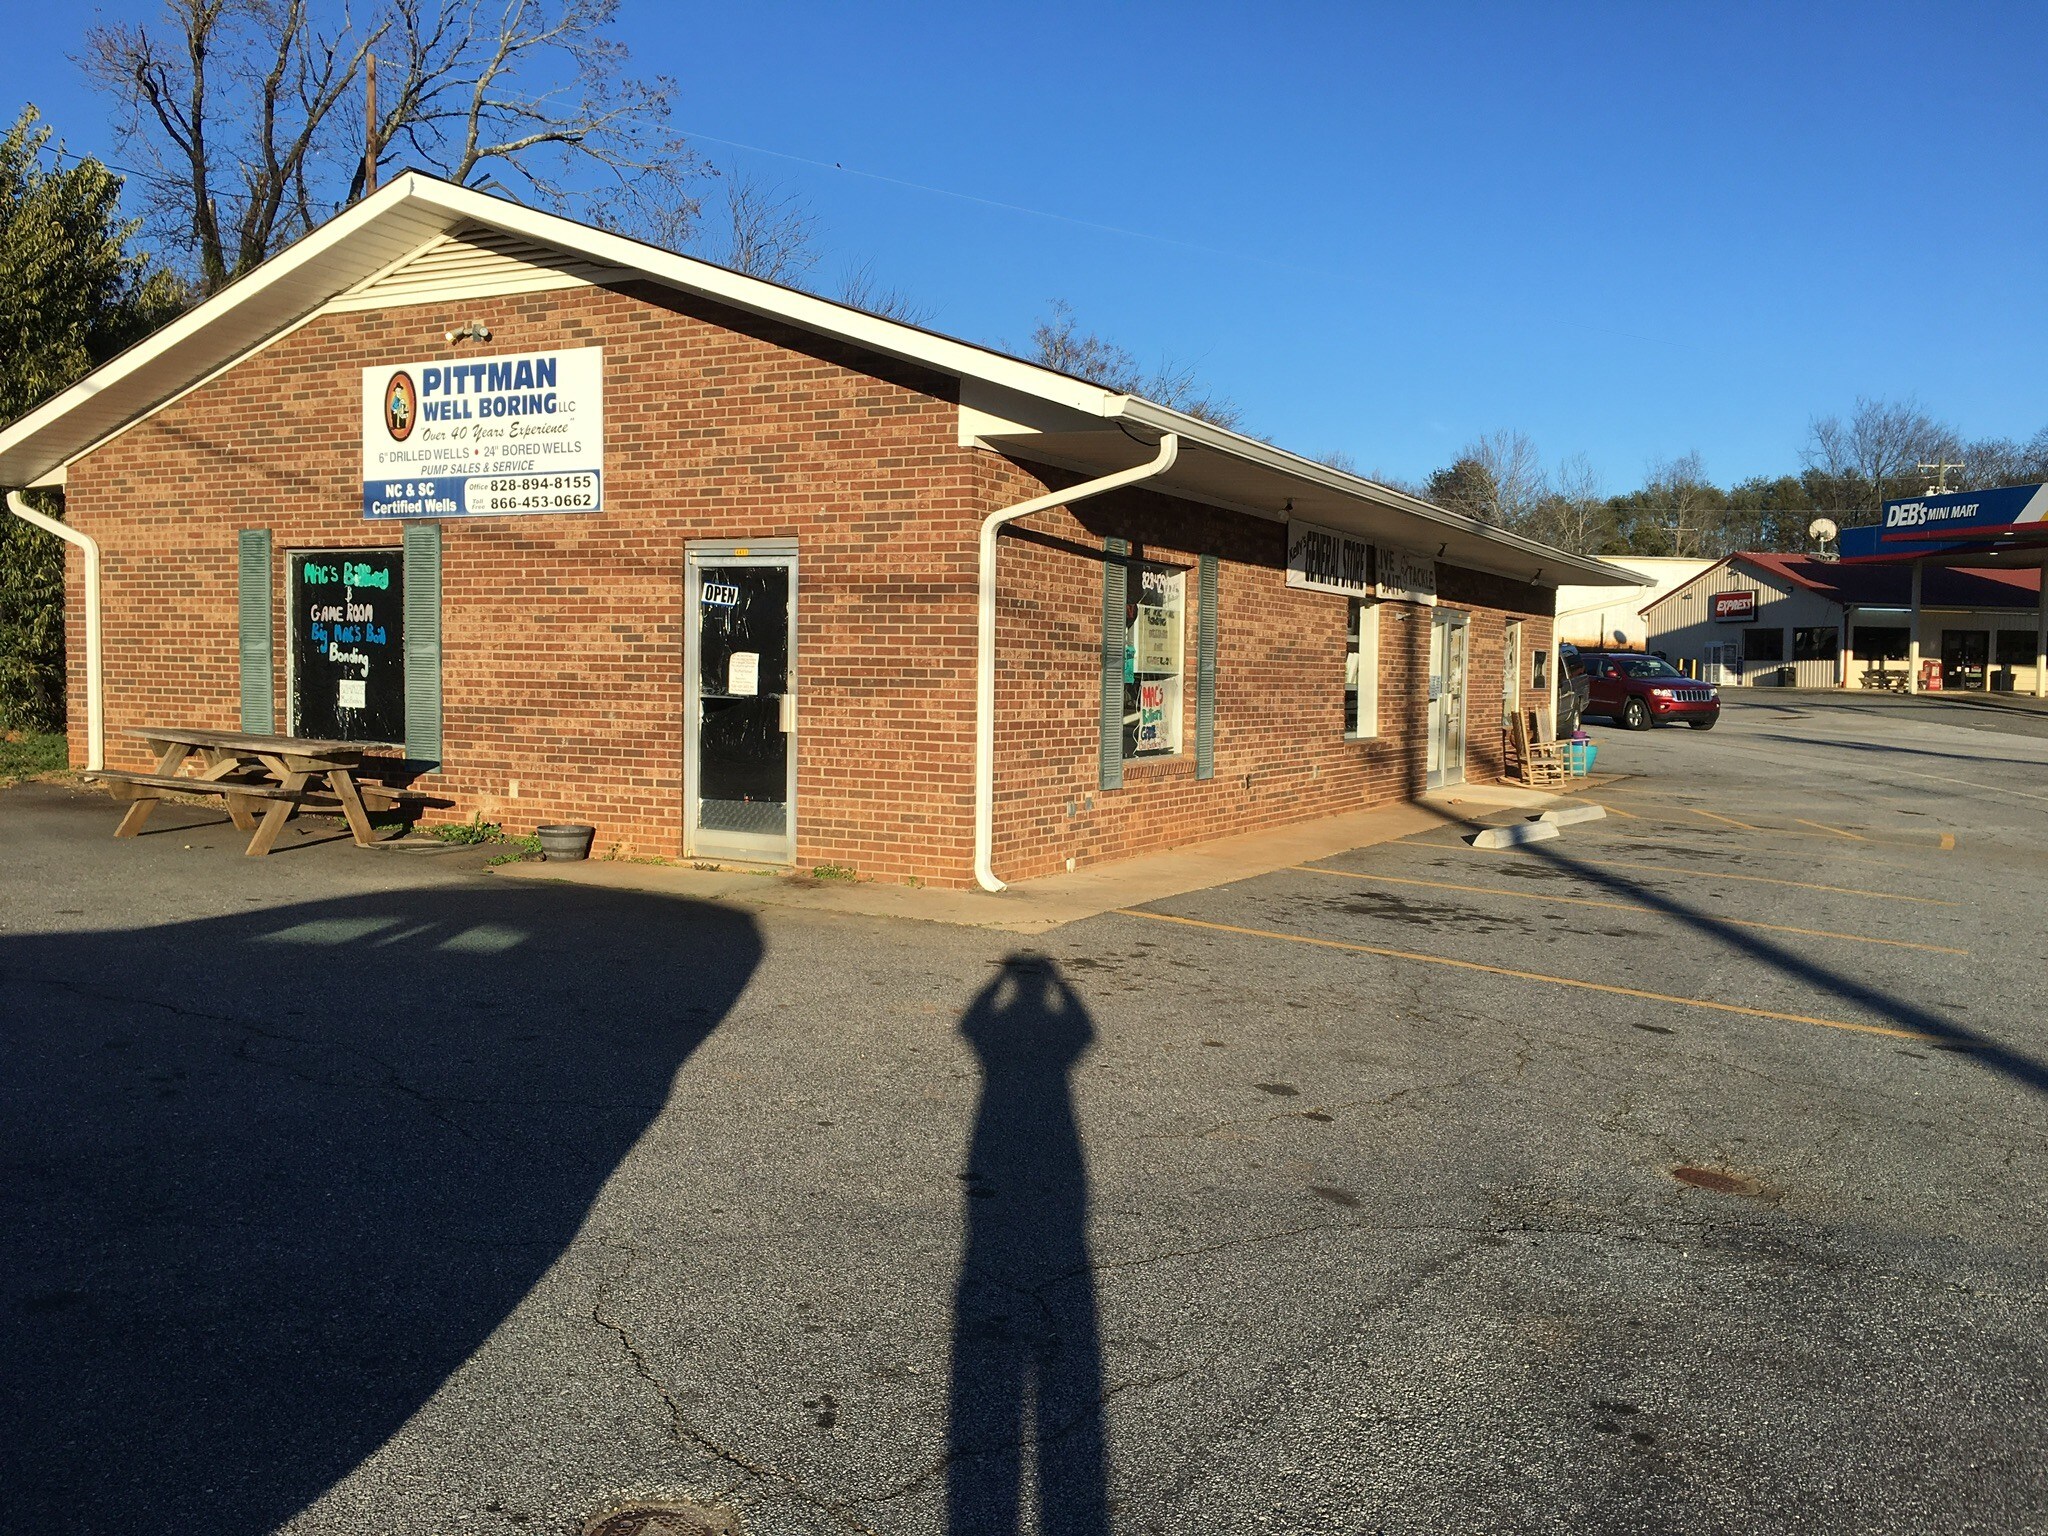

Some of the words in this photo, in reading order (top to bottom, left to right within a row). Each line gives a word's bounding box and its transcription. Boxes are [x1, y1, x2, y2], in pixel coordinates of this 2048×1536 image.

[422, 357, 557, 397] PITTMAN
[422, 399, 473, 422] WELL
[478, 392, 557, 418] BORING
[558, 401, 576, 413] LLC
[450, 426, 468, 440] 40
[472, 424, 505, 443] Years
[390, 449, 432, 463] DRILLED
[433, 447, 470, 460] WELLS
[484, 446, 500, 458] 24"
[502, 443, 541, 457] BORED
[542, 440, 582, 454] WELLS
[420, 465, 449, 476] PUMP
[450, 463, 481, 475] SALES
[482, 462, 490, 473] &
[492, 459, 536, 472] SERVICE
[385, 483, 403, 498] NC
[405, 482, 416, 497] &
[418, 482, 435, 497] SC
[468, 483, 489, 491] Office
[490, 475, 592, 492] 828-894-8155
[372, 499, 423, 515] Certified
[424, 497, 457, 513] Wells
[490, 493, 592, 510] 866-453-0662
[1927, 506, 1951, 521] MINI
[1950, 503, 1980, 519] MART
[1305, 530, 1340, 587] GENERAL
[1341, 539, 1366, 591] STORE
[1381, 571, 1401, 596] BAIT
[1408, 565, 1435, 590] TACKLE
[704, 584, 736, 604] OPEN
[310, 604, 344, 622] GAME
[346, 602, 374, 622] ROOM
[1716, 598, 1752, 616] EXPRESS
[311, 622, 328, 654] Big
[329, 641, 369, 678] Bonding
